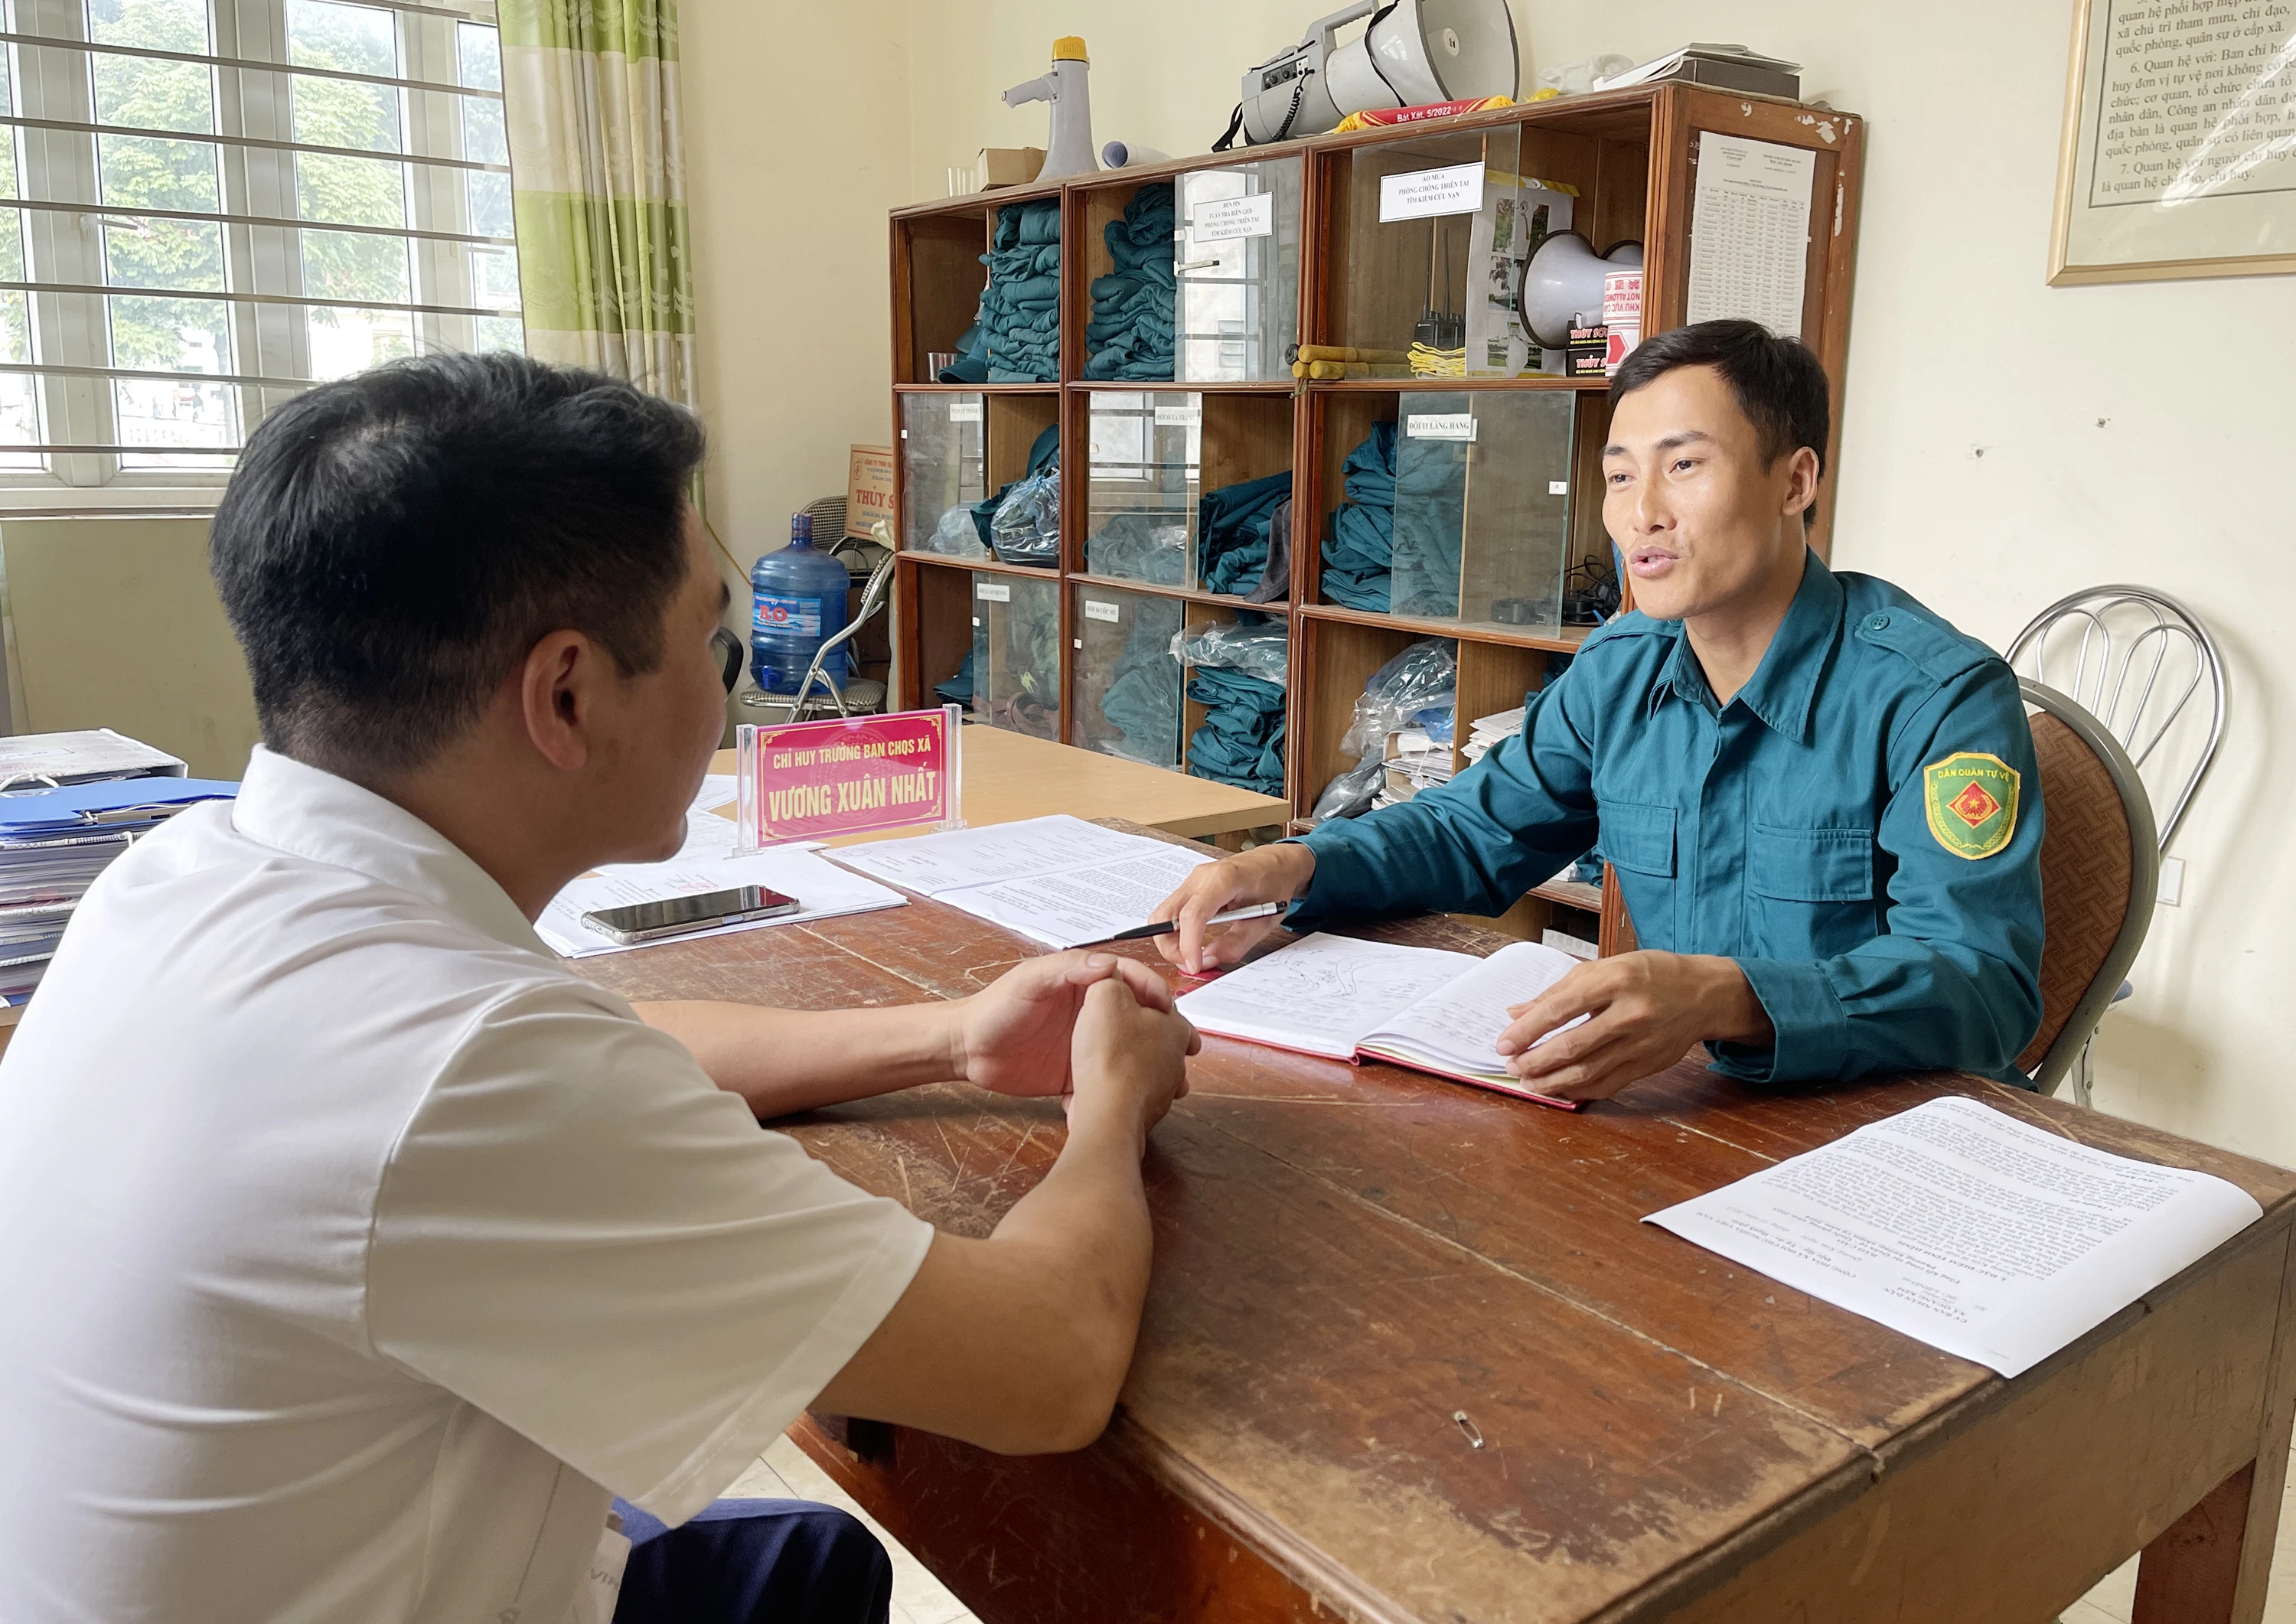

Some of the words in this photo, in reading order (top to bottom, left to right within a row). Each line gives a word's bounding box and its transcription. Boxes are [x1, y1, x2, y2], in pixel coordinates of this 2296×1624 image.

[2117, 28, 2130, 39] xã
[2134, 22, 2154, 36] chủ
[2159, 21, 2171, 32] trì
[2176, 18, 2203, 30] tham
[2265, 5, 2290, 18] đạo,
[2118, 11, 2144, 24] quan
[2148, 6, 2161, 19] hệ
[2164, 0, 2189, 18] phối
[2115, 39, 2141, 58] quốc
[2186, 31, 2213, 48] quân
[2216, 31, 2230, 41] sự
[2232, 26, 2241, 38] ở
[2244, 21, 2264, 38] cấp
[2268, 21, 2284, 33] xã.
[2131, 62, 2140, 73] 6.
[2144, 60, 2174, 73] Quan
[2177, 54, 2191, 67] hệ
[2195, 51, 2216, 64] với:
[2221, 49, 2243, 60] Ban
[2112, 81, 2132, 93] huy
[2135, 77, 2155, 89] đơn
[2159, 73, 2170, 87] vị
[2174, 74, 2186, 85] tự
[2189, 70, 2202, 83] vệ
[2205, 66, 2223, 80] nơi
[2227, 63, 2263, 76] không
[2144, 94, 2158, 103] cơ
[2161, 90, 2192, 103] quan,
[2197, 82, 2208, 96] tổ
[2213, 81, 2242, 94] chức
[1427, 106, 1451, 118] 5/2022
[2109, 111, 2134, 124] nhân
[2138, 109, 2162, 120] dân,
[2167, 105, 2198, 117] Công
[2203, 103, 2216, 112] an
[2255, 95, 2276, 106] dân
[2107, 129, 2124, 142] địa
[2129, 126, 2149, 138] bàn
[2155, 123, 2164, 134] là
[2170, 122, 2197, 135] quan
[2203, 117, 2218, 130] hệ
[2255, 112, 2281, 125] hợp,
[2105, 141, 2132, 159] quốc
[2135, 141, 2172, 156] phòng,
[2176, 135, 2203, 151] quân
[2225, 132, 2239, 143] có
[2242, 129, 2263, 142] liên
[2120, 163, 2129, 174] 7.
[2134, 161, 2164, 174] Quan
[2167, 158, 2181, 171] hệ
[1398, 186, 1417, 195] PHÒNG
[1440, 181, 1457, 190] THIÊN
[2102, 181, 2111, 192] là
[2114, 181, 2141, 194] quan
[2144, 176, 2157, 190] hệ
[2161, 174, 2177, 187] ch
[1625, 303, 1640, 311] KHU
[1576, 354, 1600, 368] THỦY
[1409, 420, 1420, 431] ĐỘI
[856, 485, 885, 507] THỦY
[773, 748, 792, 770] CHỈ
[794, 748, 816, 767] HUY
[819, 742, 861, 764] TRƯỞNG
[863, 742, 885, 759] BAN
[888, 740, 915, 757] CHQS
[917, 734, 931, 752] XÃ
[1938, 768, 1956, 779] DÂN
[1958, 767, 1984, 777] QUÂN
[1985, 769, 1998, 779] TỰ
[2000, 771, 2010, 782] VỆ
[769, 784, 831, 823] VƯƠNG
[837, 773, 885, 813] XUÂN
[891, 761, 936, 806] NHẤT
